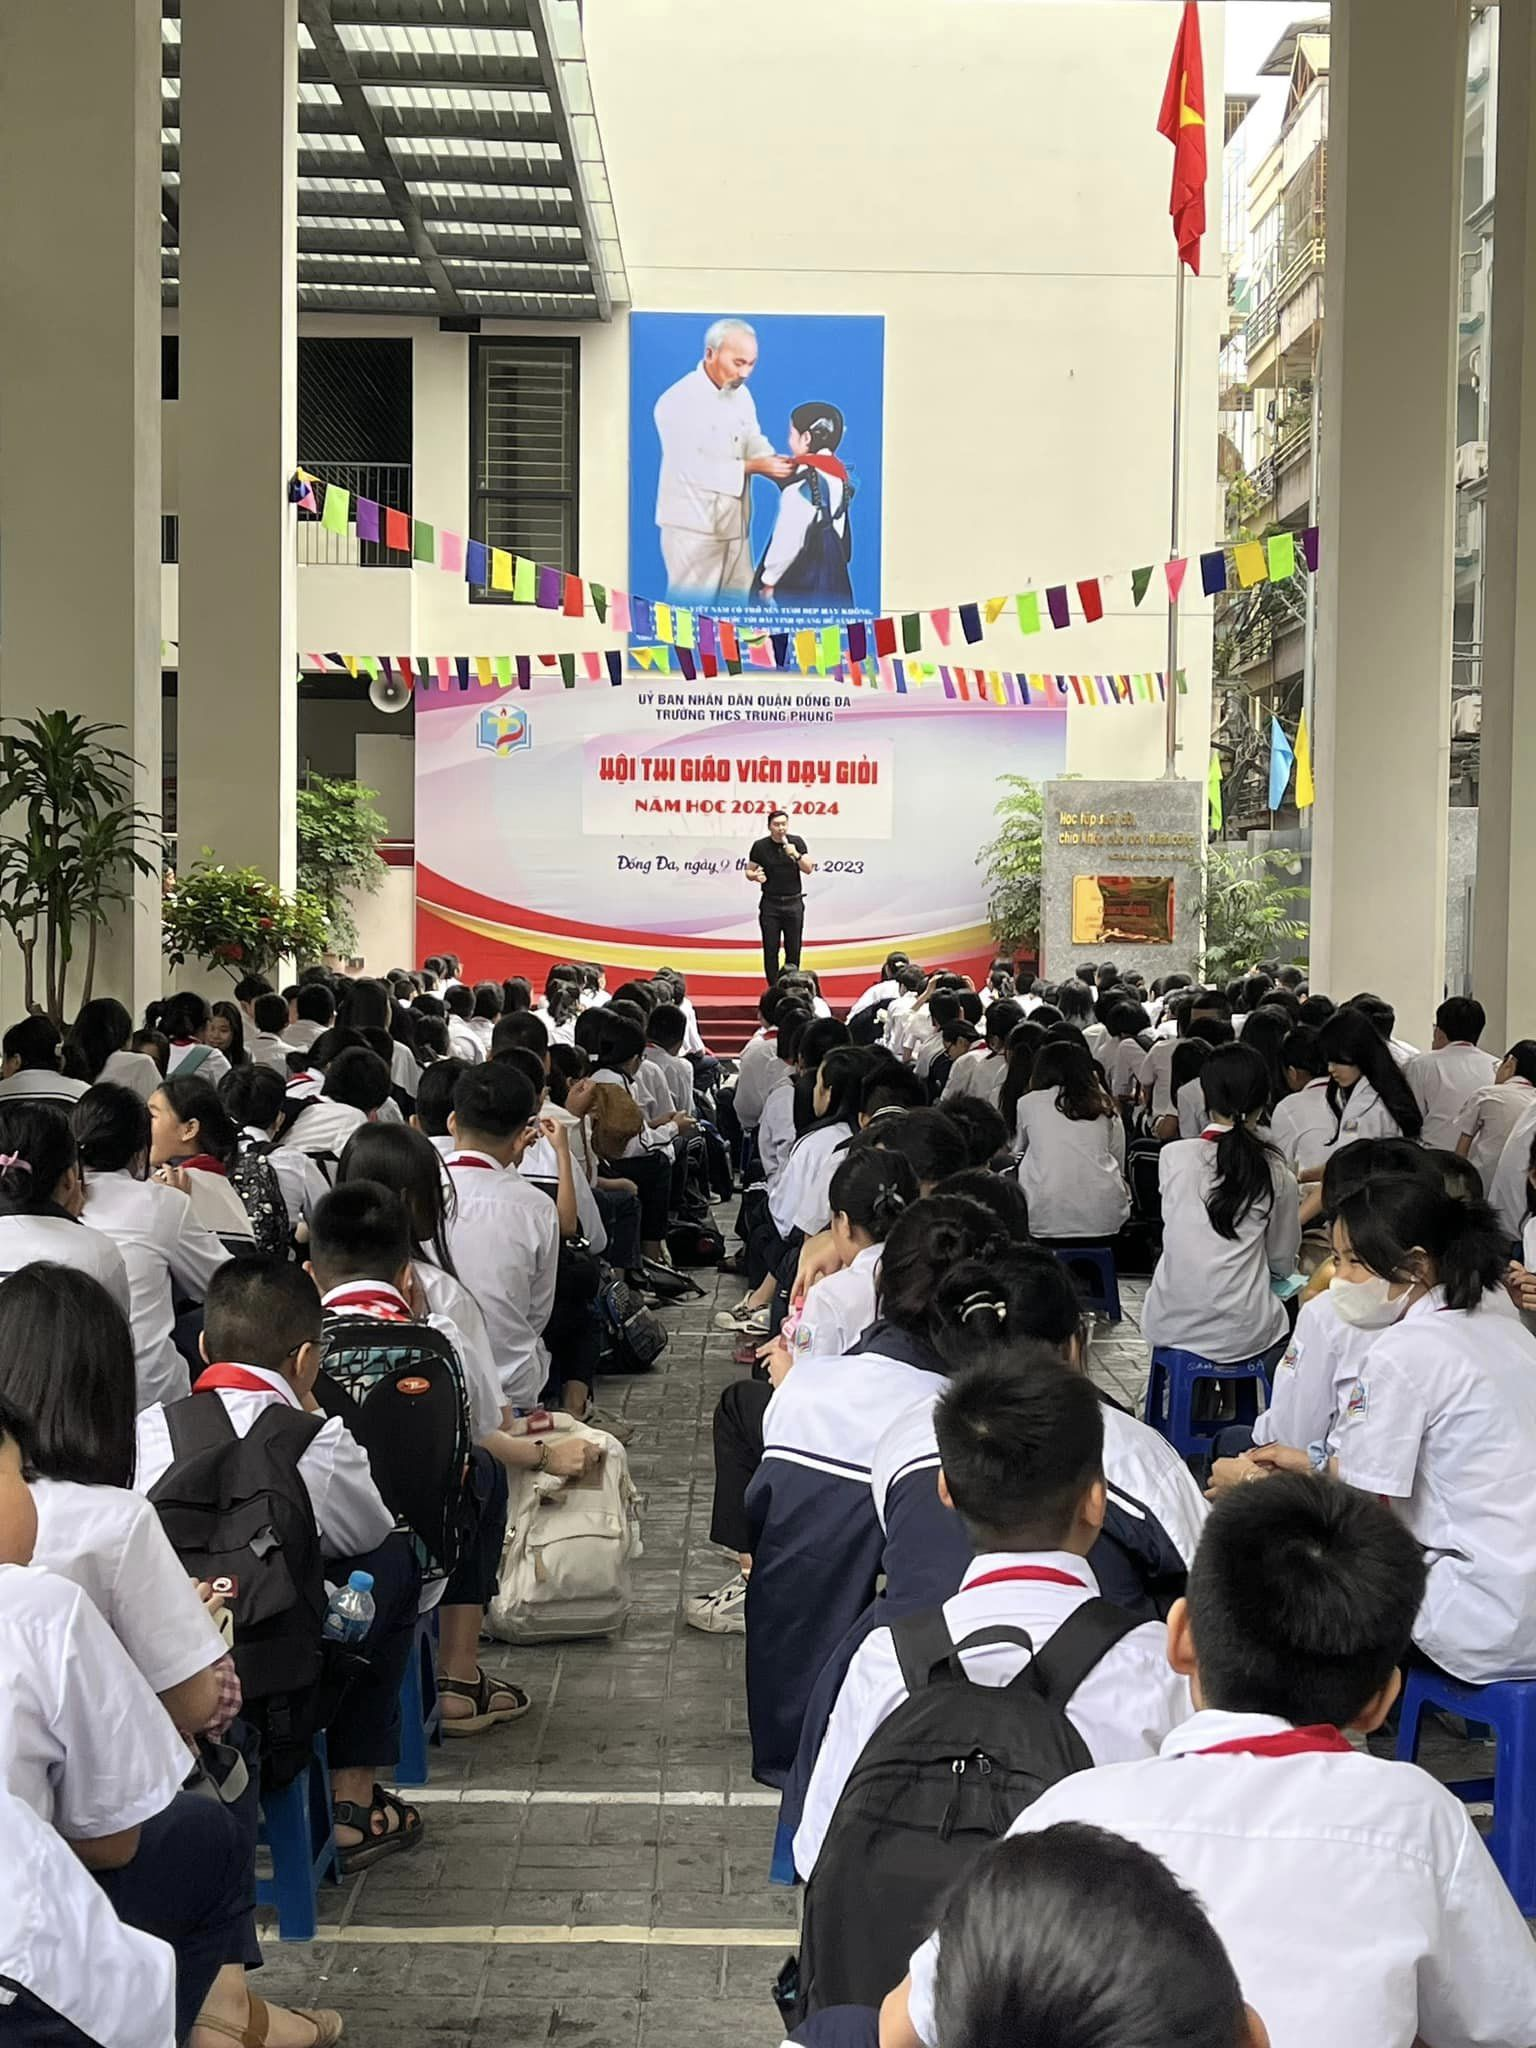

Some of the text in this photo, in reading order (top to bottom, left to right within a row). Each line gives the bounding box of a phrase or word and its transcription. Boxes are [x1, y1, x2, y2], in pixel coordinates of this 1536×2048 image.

[658, 694, 684, 706] BAN
[688, 692, 723, 706] NHÂN
[728, 693, 753, 706] DÂN
[757, 692, 792, 709] QUẬN
[656, 707, 706, 721] TRƯỜNG
[709, 710, 741, 721] THCS
[745, 710, 786, 722] TRUNG
[600, 753, 636, 785] HỘI
[641, 758, 675, 781] THI
[680, 754, 730, 782] GIÁO
[787, 760, 831, 788] DẠY
[836, 754, 878, 785] GIỎI
[635, 795, 681, 813] NĂM
[686, 799, 727, 816] HỌC
[731, 800, 777, 814] 2023
[791, 801, 839, 815] 2024
[617, 855, 652, 874] Đống
[656, 855, 680, 872] Đa,
[684, 857, 719, 875] ngày
[823, 860, 865, 874] 2023
